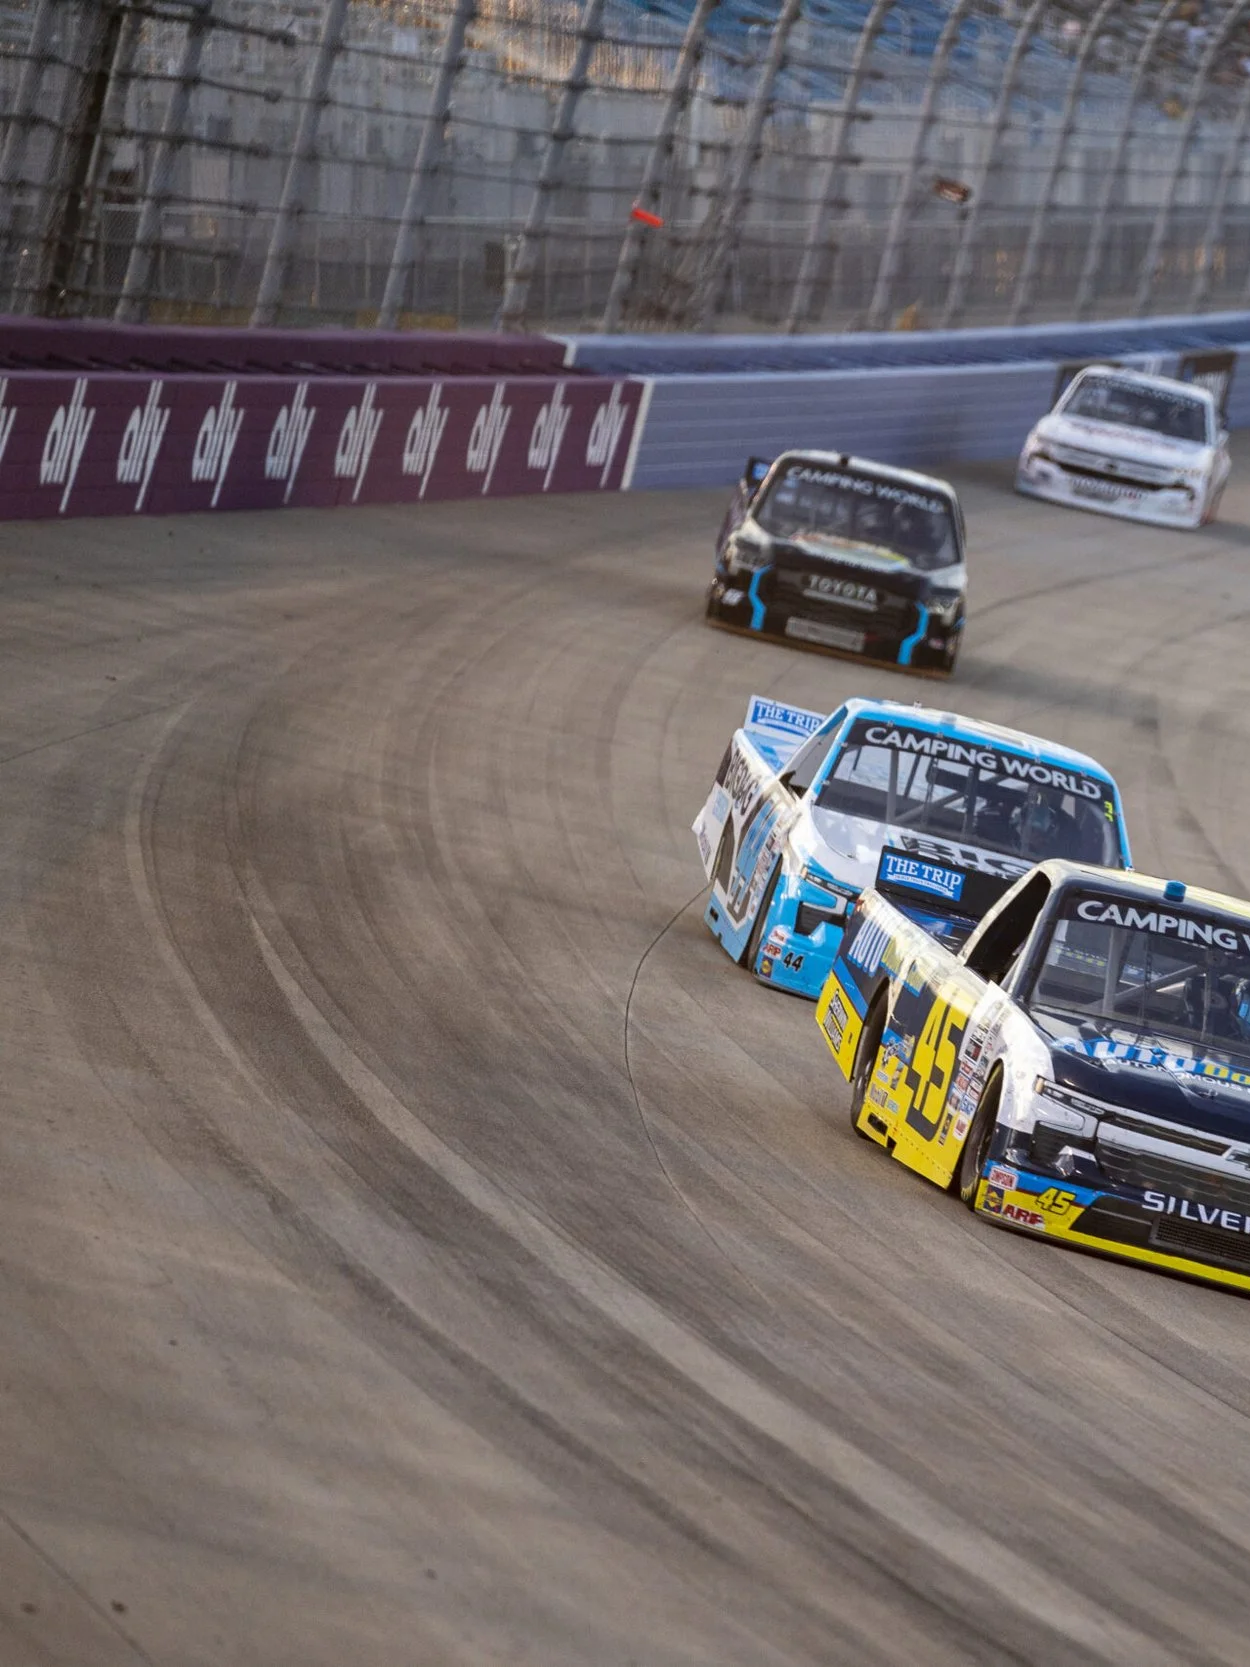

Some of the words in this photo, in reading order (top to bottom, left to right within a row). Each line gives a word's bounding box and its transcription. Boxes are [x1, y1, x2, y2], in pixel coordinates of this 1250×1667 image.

[808, 574, 878, 602] TOYOTA
[756, 702, 784, 720] THE
[865, 727, 997, 770] CAMPING
[1001, 756, 1102, 800] WORLD
[885, 855, 919, 876] THE
[921, 864, 962, 891] TRIP
[1077, 900, 1239, 950] CAMPING
[782, 951, 804, 972] 44
[1036, 1186, 1078, 1216] 45
